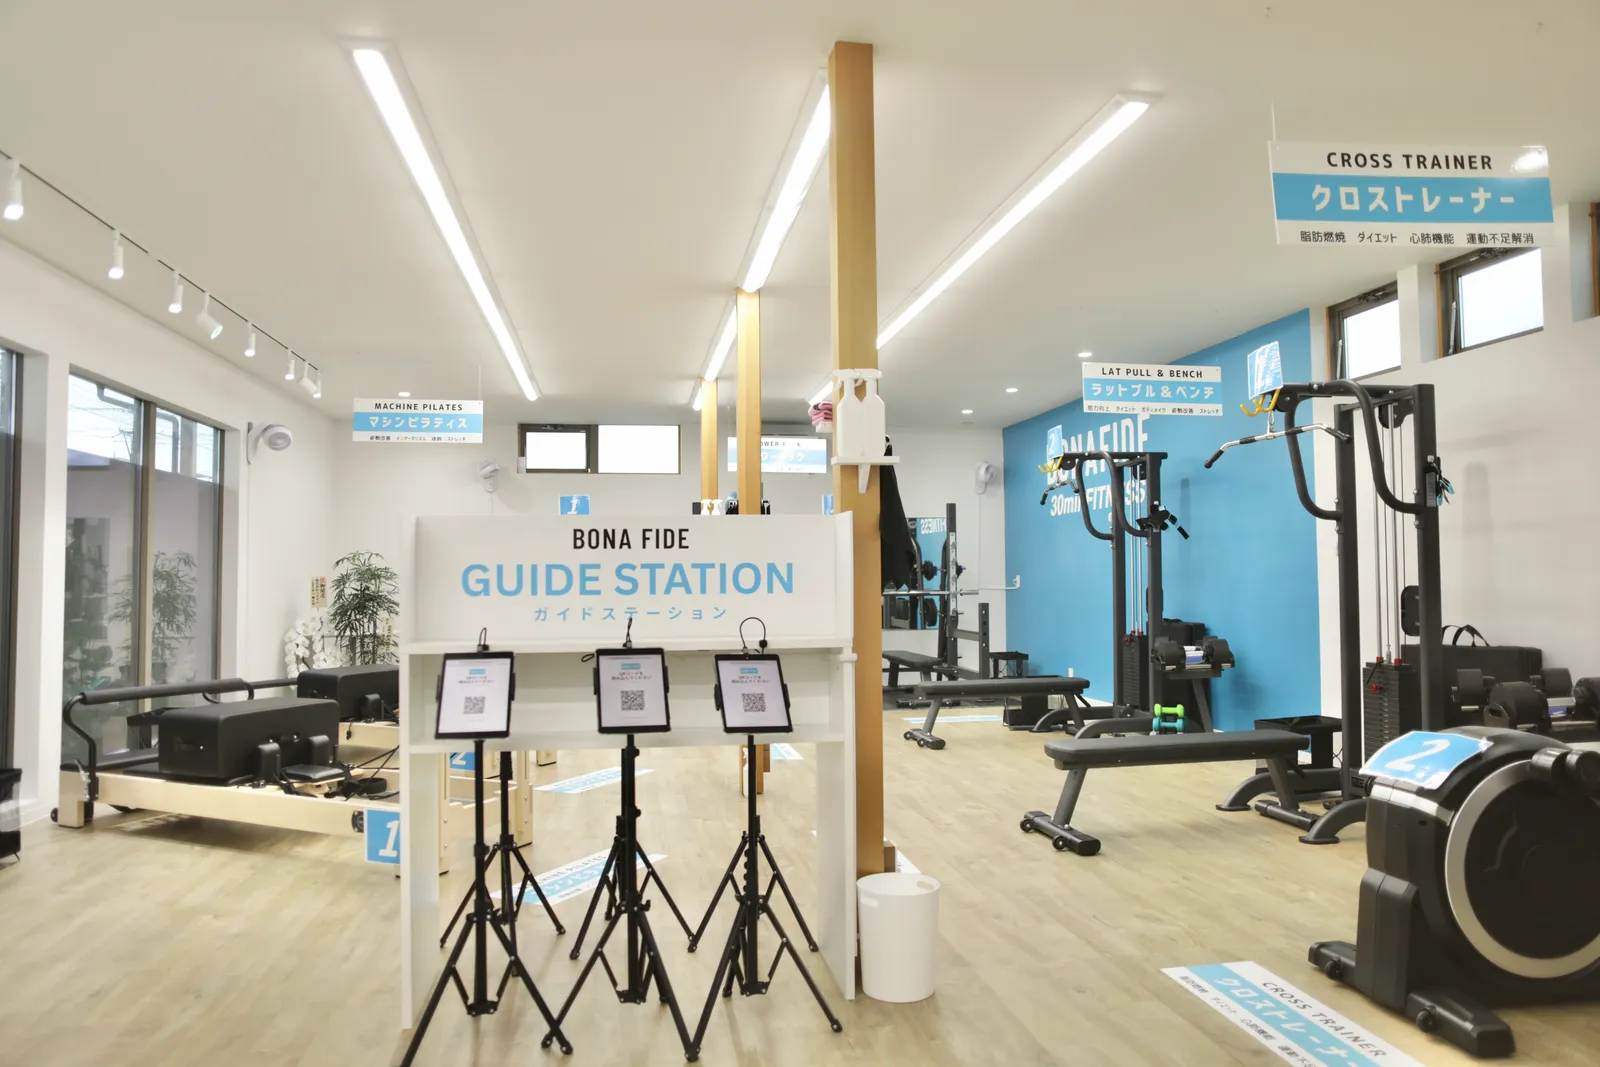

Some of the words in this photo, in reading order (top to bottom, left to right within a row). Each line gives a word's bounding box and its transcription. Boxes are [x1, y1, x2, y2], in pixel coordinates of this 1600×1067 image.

[1326, 151, 1393, 169] CROSS
[1402, 154, 1493, 171] TRAINER
[1311, 184, 1515, 214] クロストレーナー
[1300, 231, 1346, 243] 脂肪燃焼
[1357, 232, 1398, 243] ダイエット
[1409, 233, 1455, 244] 心肺機能
[1466, 233, 1534, 244] 運動不足解消
[1101, 367, 1121, 376] LAT
[1126, 368, 1151, 377] PULL
[1157, 369, 1164, 377] &
[1169, 370, 1203, 378] BENCH
[374, 402, 419, 411] MACHINE
[422, 403, 463, 411] PILATES
[368, 416, 468, 429] マシンピラティス
[1086, 479, 1147, 511] FITNSS
[572, 528, 631, 550] BONA
[641, 528, 690, 550] FIDE
[461, 563, 602, 597] GUIDE
[614, 562, 794, 596] STATION
[534, 606, 728, 622] ガイドステーション
[1384, 739, 1450, 772] 2
[378, 819, 400, 858] 1
[1262, 981, 1313, 1011] CROSS
[1311, 1012, 1388, 1057] TRAINER
